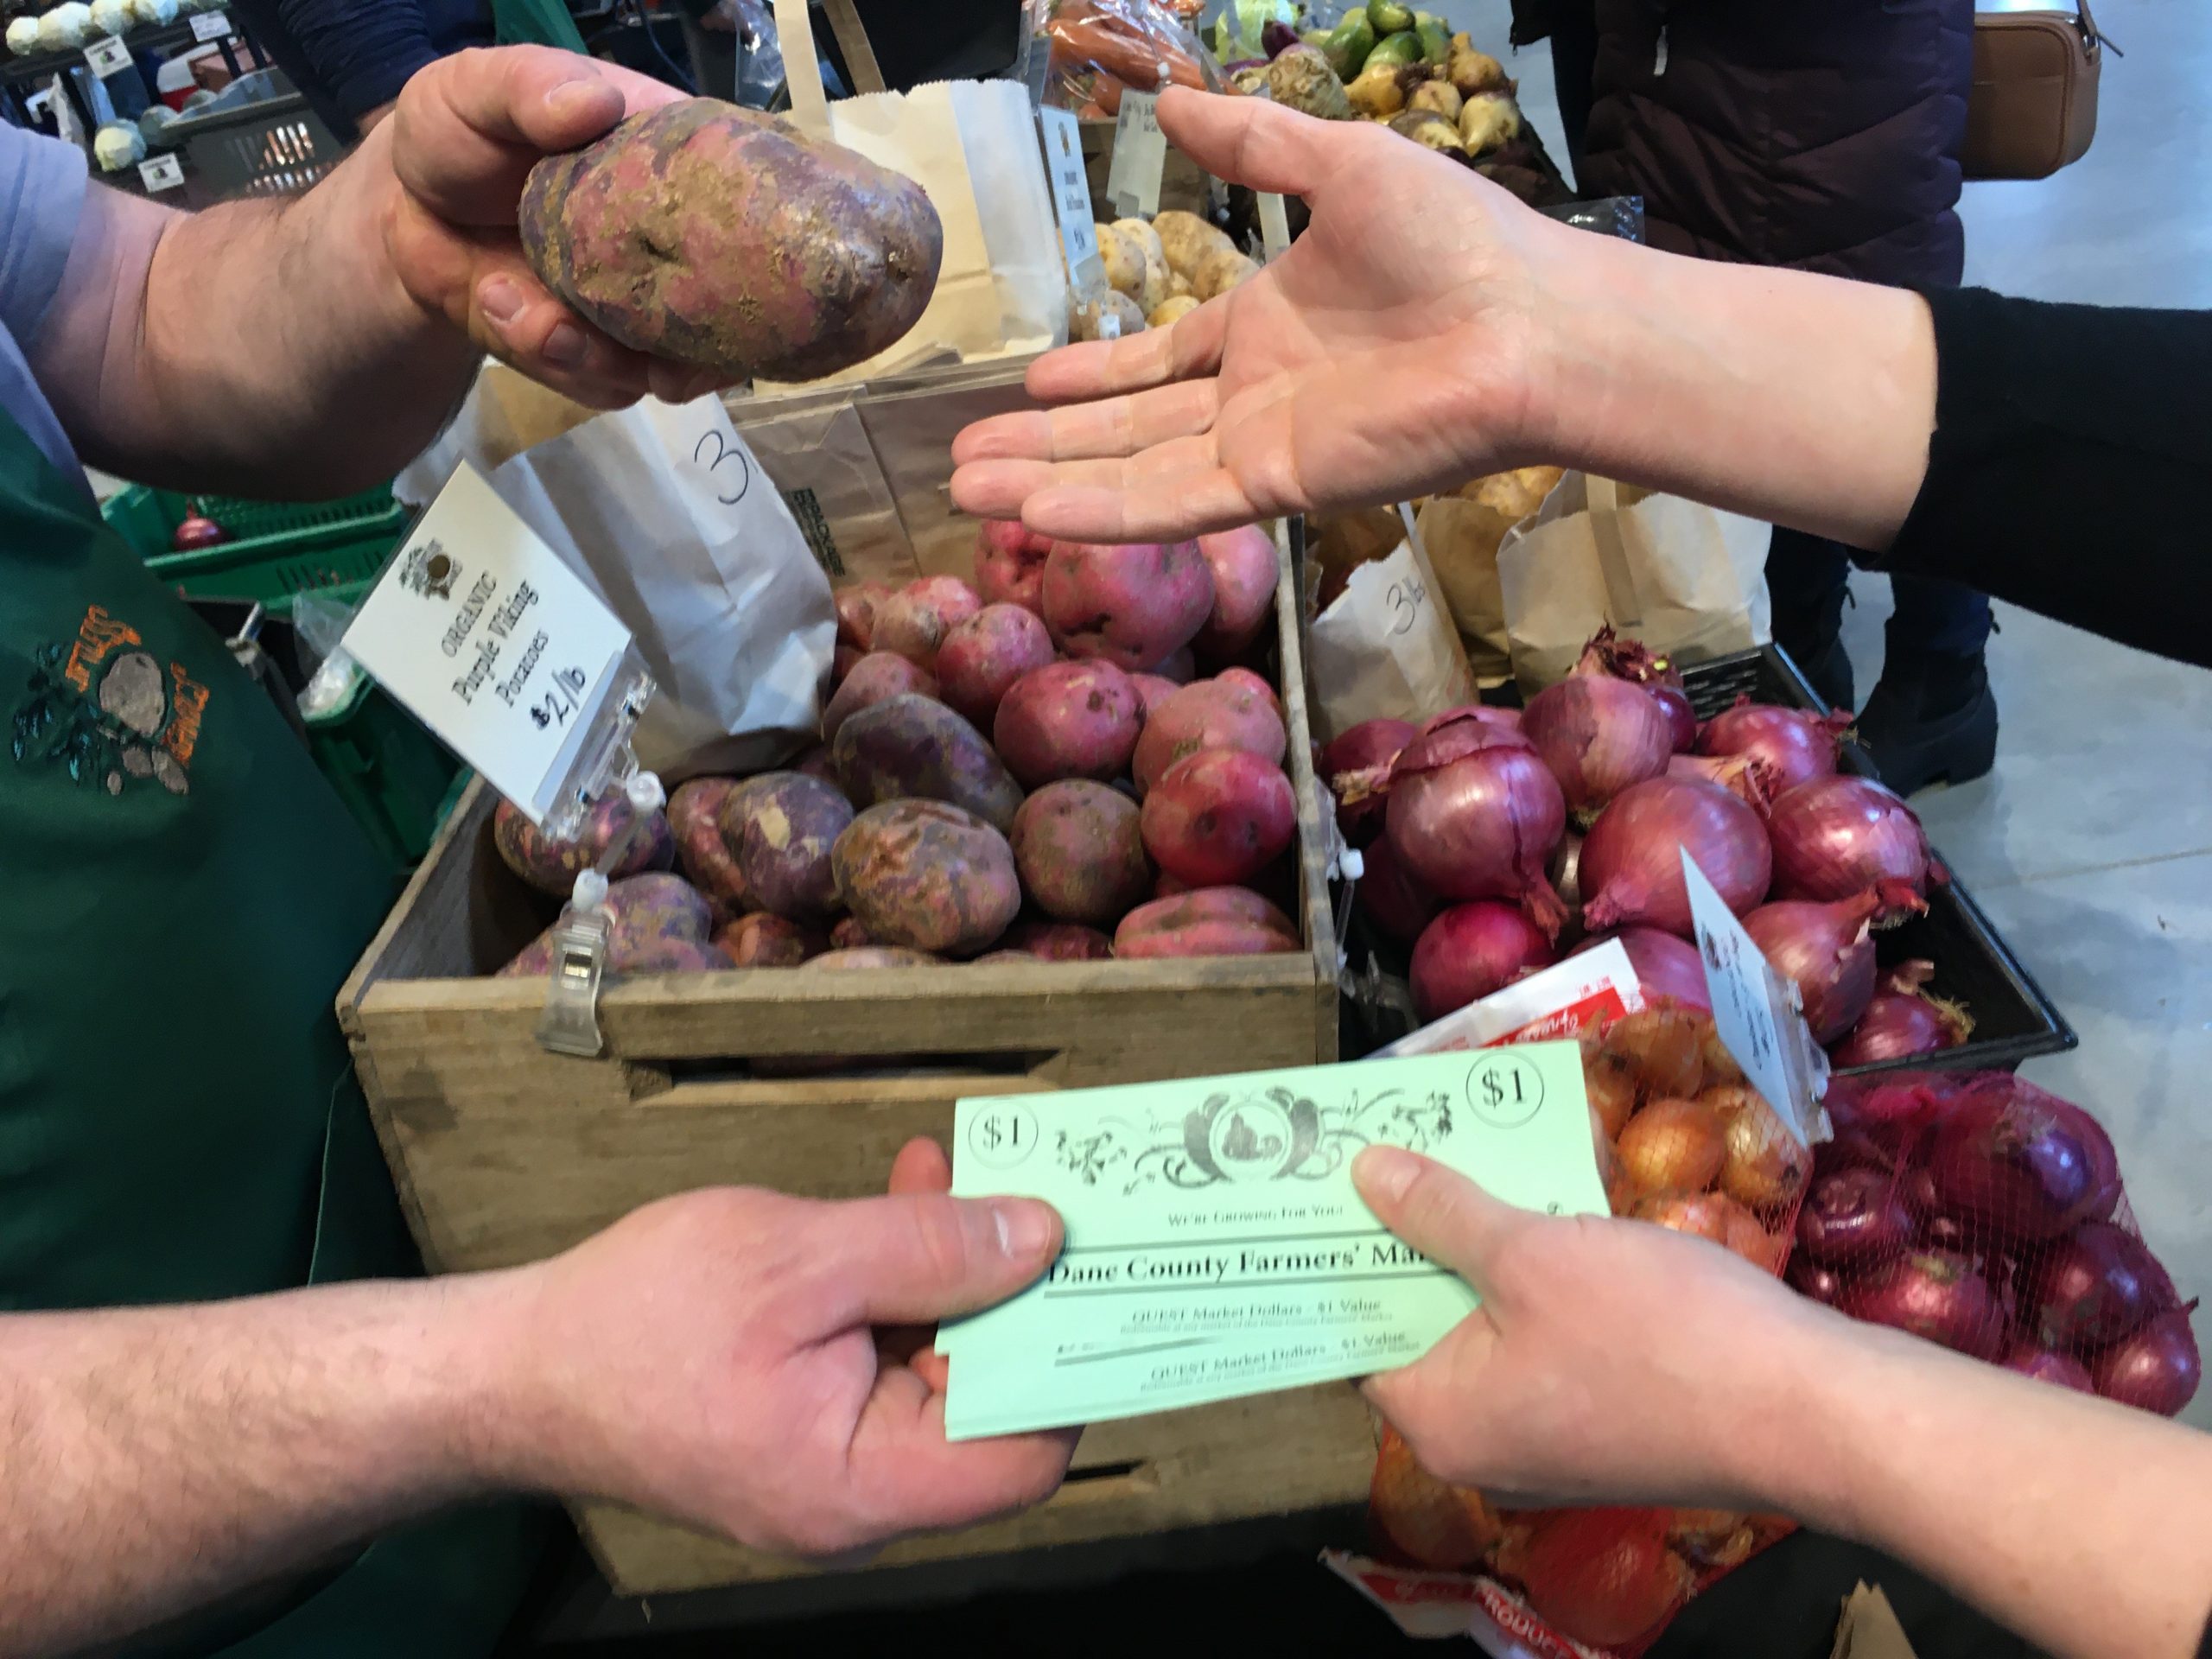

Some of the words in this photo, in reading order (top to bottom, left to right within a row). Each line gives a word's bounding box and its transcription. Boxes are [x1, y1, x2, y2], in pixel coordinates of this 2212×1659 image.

[442, 569, 497, 658] ORGANIC
[451, 639, 500, 707] Purple
[487, 577, 539, 640] Viking
[494, 628, 550, 709] Potatoes
[1481, 1066, 1528, 1109] $1
[982, 1114, 1021, 1152] $1
[1047, 1261, 1118, 1284] Dane
[1127, 1255, 1230, 1284] County
[1239, 1243, 1361, 1273] Farmers'
[1372, 1243, 1426, 1266] Mar
[1193, 1302, 1244, 1321] Market
[1340, 1297, 1382, 1313] Value
[1214, 1351, 1268, 1371] Market
[1363, 1331, 1406, 1347] Value
